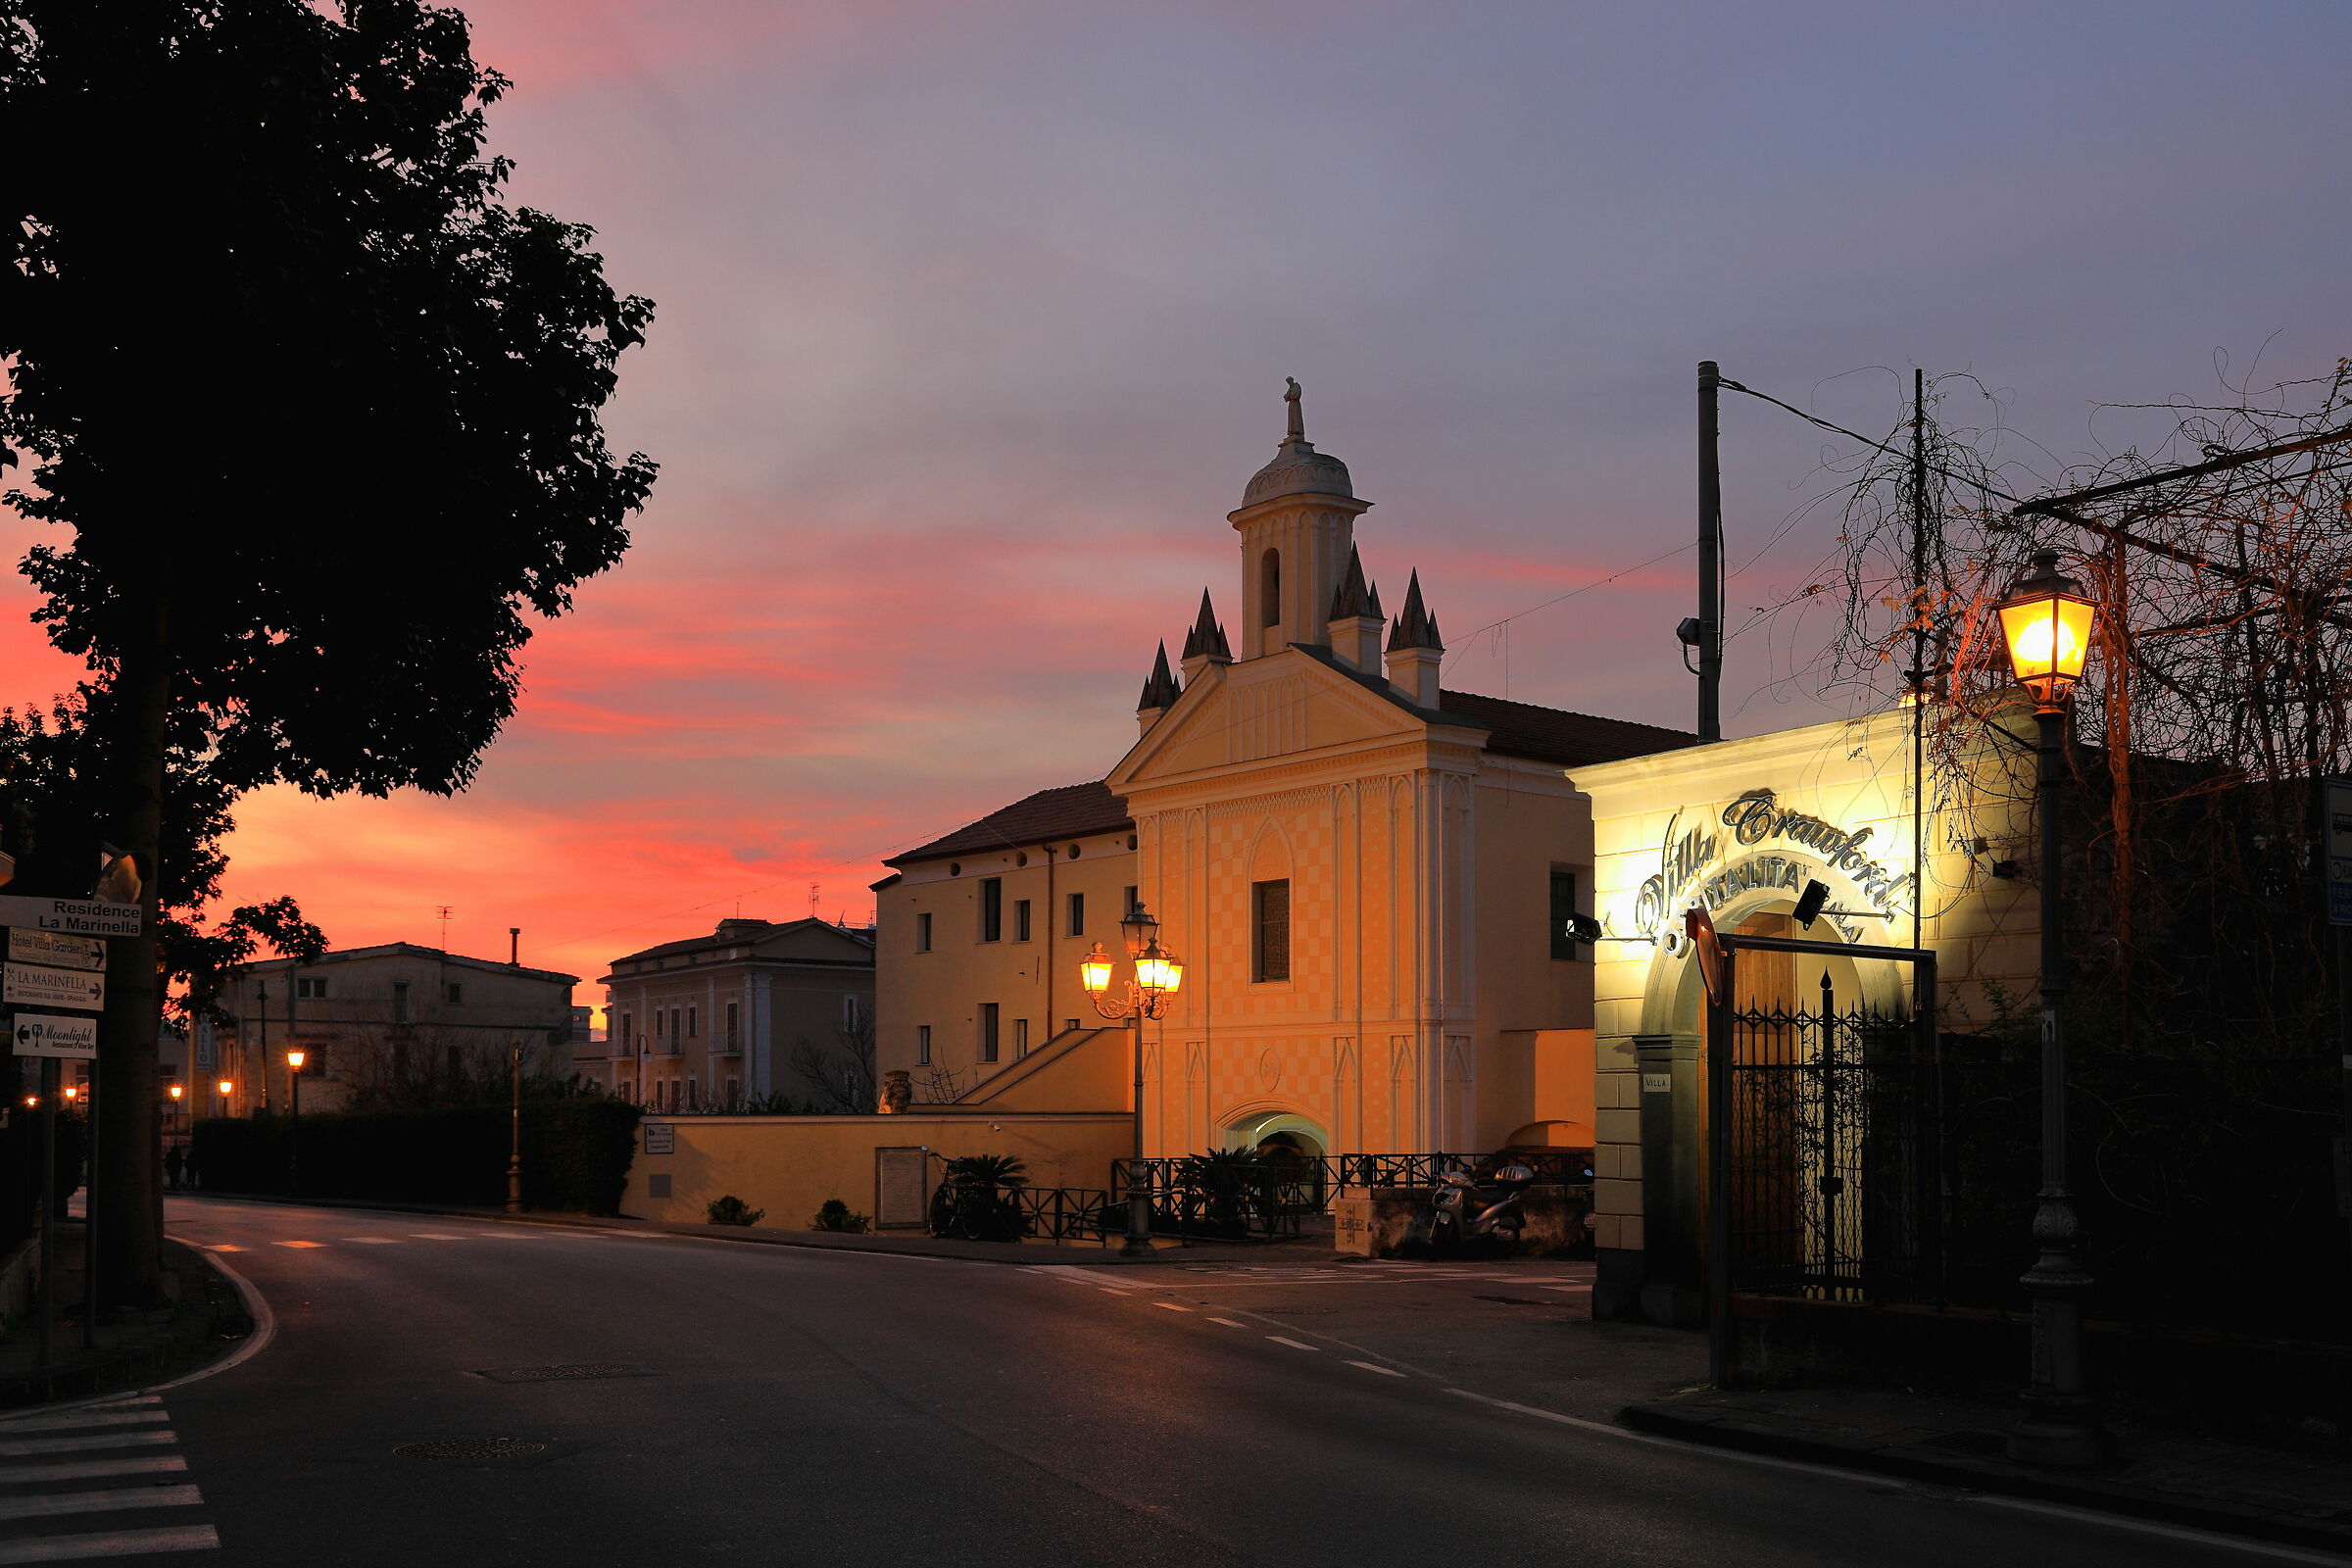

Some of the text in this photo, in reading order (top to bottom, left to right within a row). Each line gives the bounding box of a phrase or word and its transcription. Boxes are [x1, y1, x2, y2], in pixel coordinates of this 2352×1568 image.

[1636, 794, 1910, 934] Villa Crawford
[54, 901, 140, 918] Residence
[39, 915, 138, 933] La Marinella
[12, 933, 82, 955] Hotel Villa Garden
[18, 971, 86, 990] LA MARINELLA
[42, 1024, 92, 1049] Moonlight
[1645, 1077, 1666, 1087] VILLA
